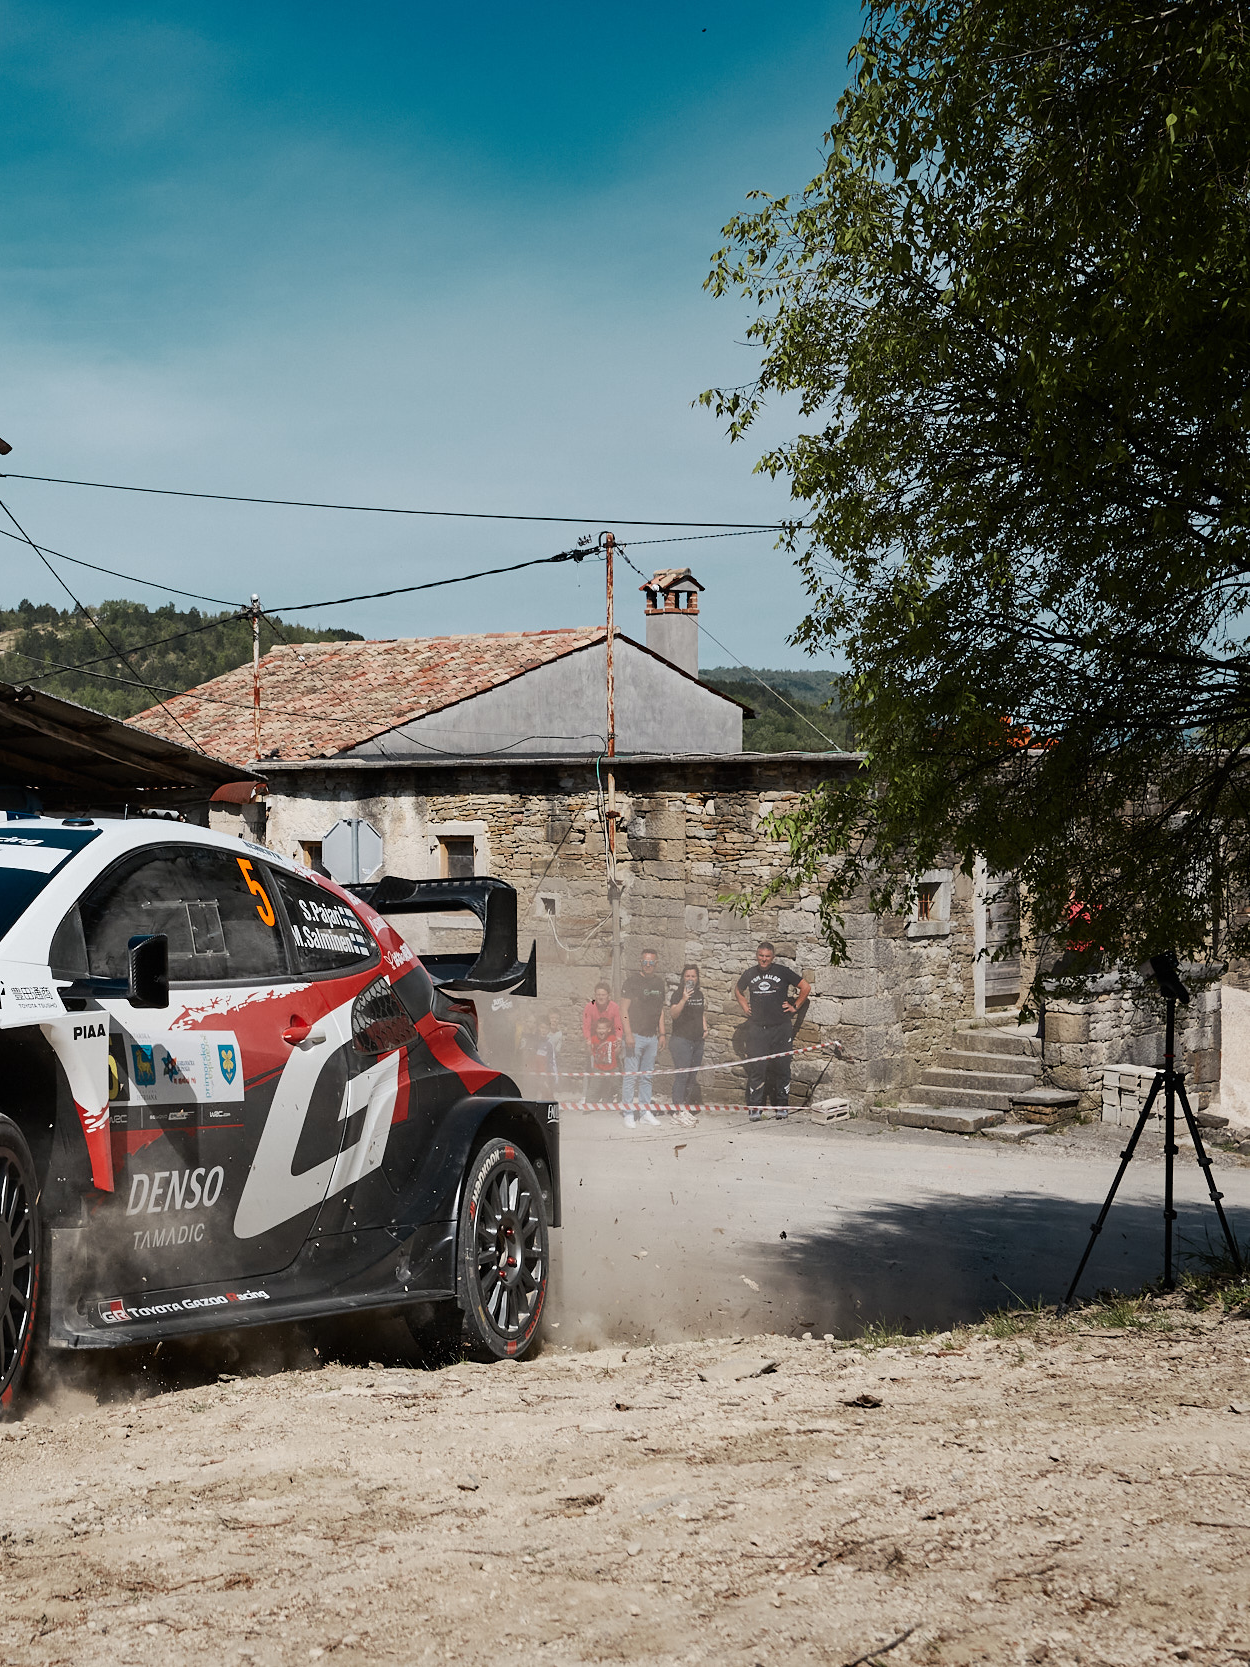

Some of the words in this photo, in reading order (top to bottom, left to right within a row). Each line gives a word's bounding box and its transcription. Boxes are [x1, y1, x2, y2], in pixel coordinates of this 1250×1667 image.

[235, 856, 276, 927] 5
[298, 899, 345, 929] S.Pajari
[291, 924, 355, 953] M.Salminen
[73, 1023, 106, 1040] PIAA
[126, 1165, 225, 1217] DENSO
[132, 1223, 205, 1250] TAMADIC
[127, 1302, 183, 1318] TOYOTA
[181, 1294, 229, 1310] GAZOO
[226, 1289, 271, 1302] Racing
